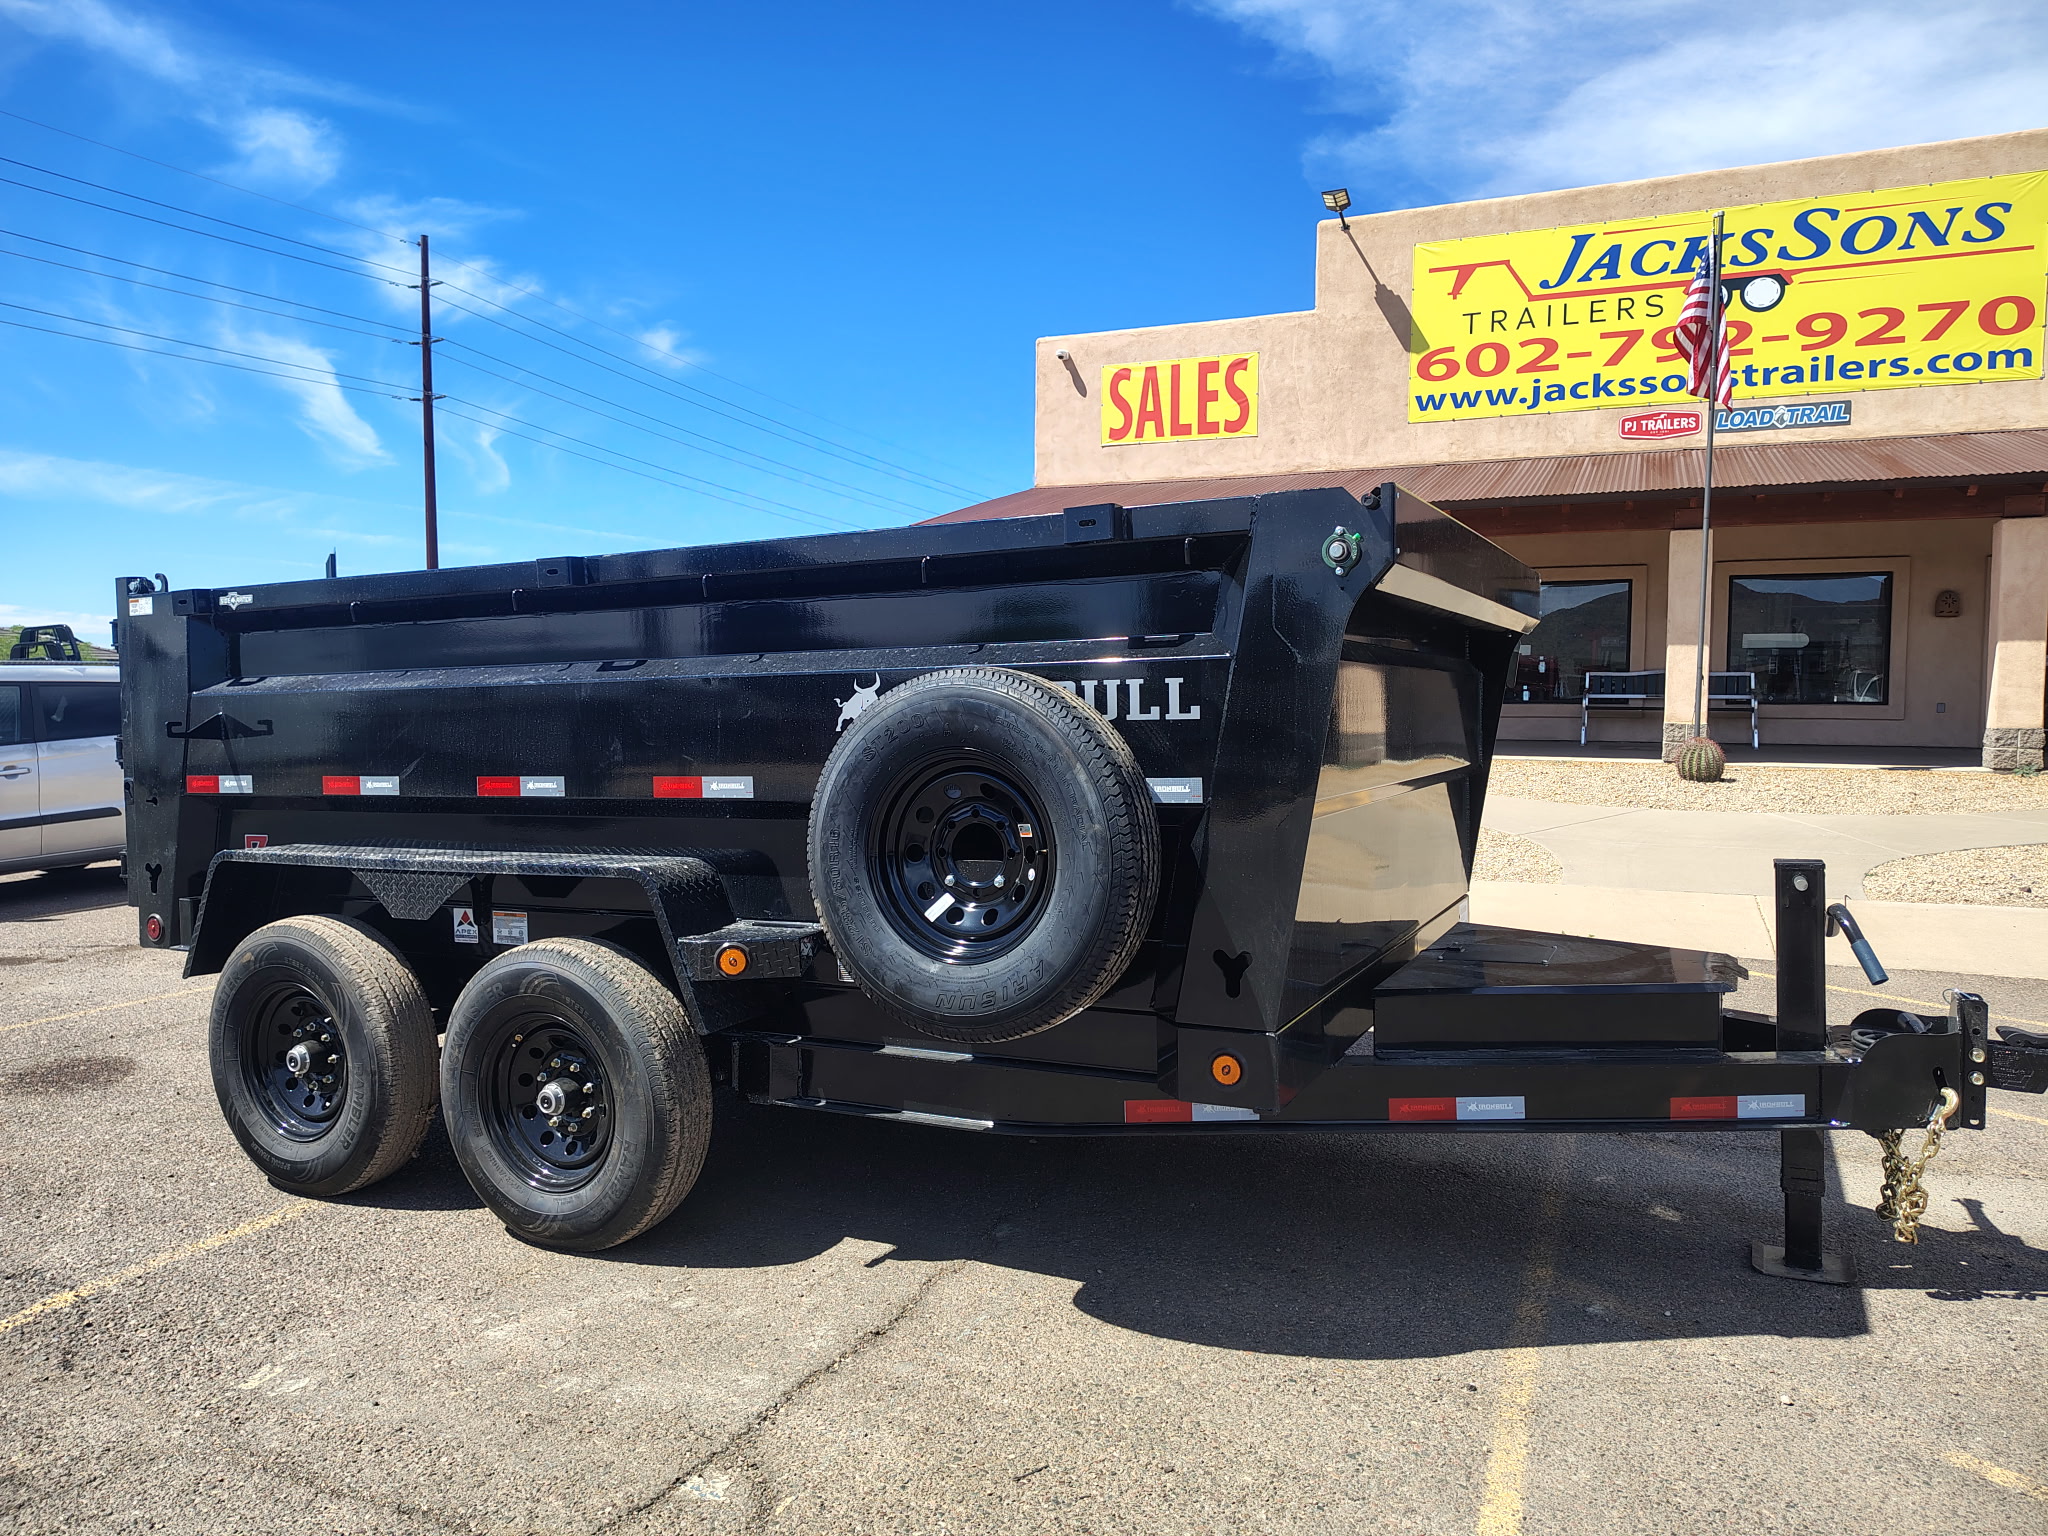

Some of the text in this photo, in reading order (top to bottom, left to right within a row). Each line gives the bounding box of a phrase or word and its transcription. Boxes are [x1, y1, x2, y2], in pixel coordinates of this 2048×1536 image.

[1463, 294, 1664, 335] TRAILERS
[1108, 358, 1250, 440] SALES
[1415, 347, 2035, 412] www.jackssotrailers.com
[1624, 416, 1696, 433] PJ TRAILERS
[1716, 404, 1849, 429] LOAD TRAIL
[1054, 677, 1201, 721] ULL
[935, 959, 1044, 1010] ARISUN
[340, 1062, 366, 1151] RAMBLER
[1478, 1101, 1514, 1111] IRONBULL
